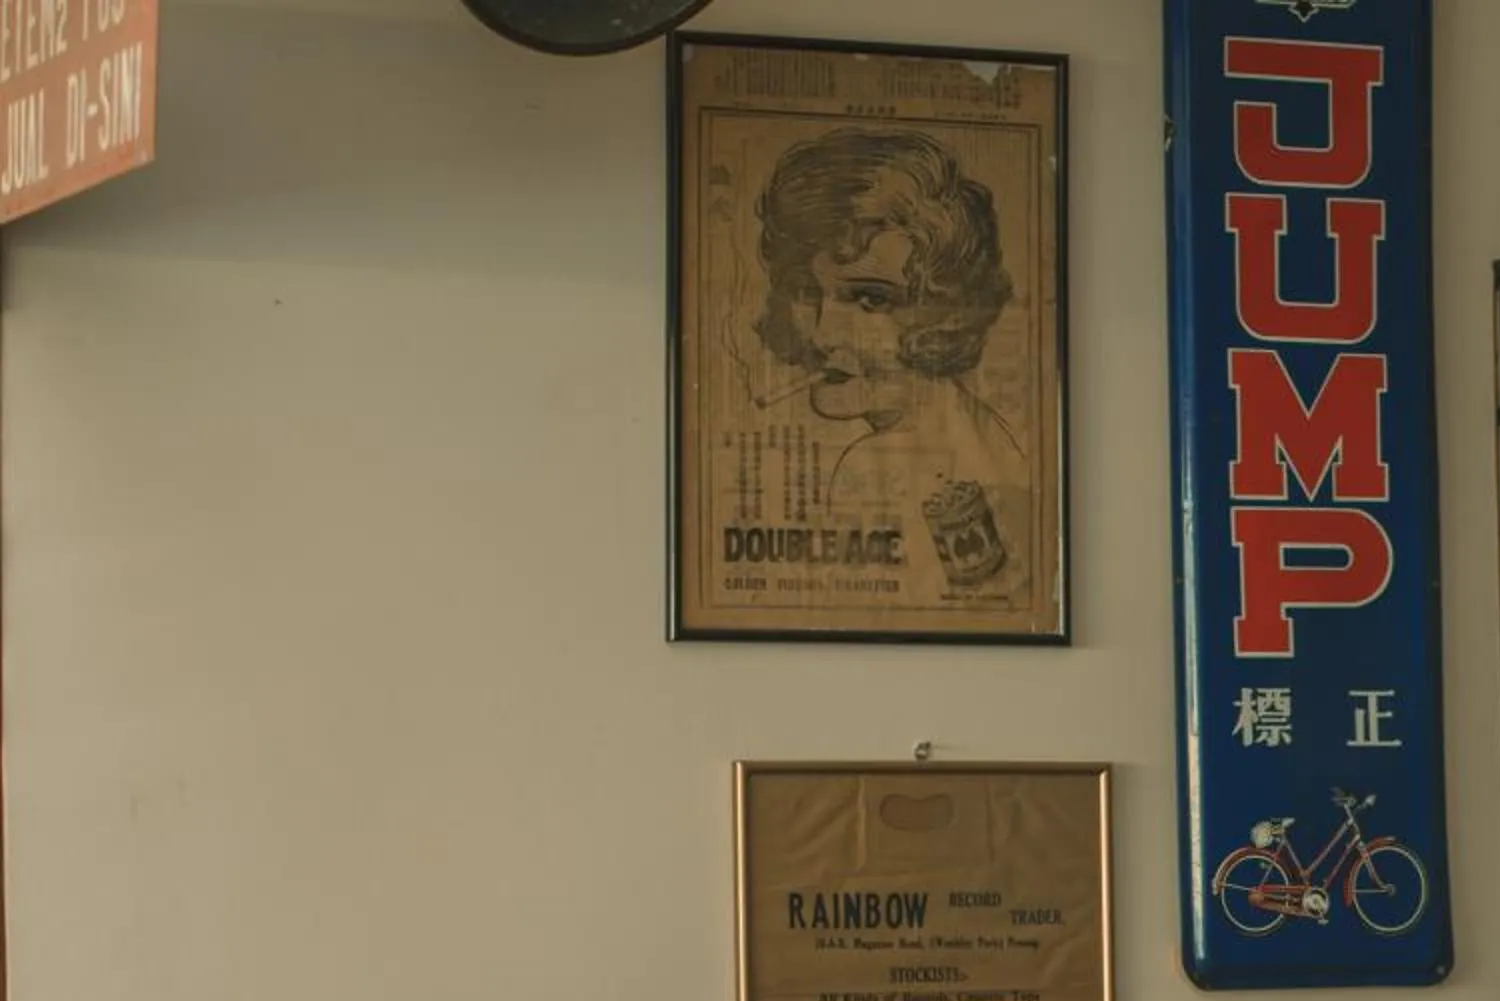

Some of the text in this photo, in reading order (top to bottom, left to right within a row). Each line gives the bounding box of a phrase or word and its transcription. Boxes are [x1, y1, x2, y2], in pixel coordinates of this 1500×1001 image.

[1, 40, 143, 194] JUAL DI-SINI
[1224, 36, 1394, 658] JUMP
[724, 526, 838, 565] DOUBLE
[788, 892, 1002, 929] RAINBOW RECORD
